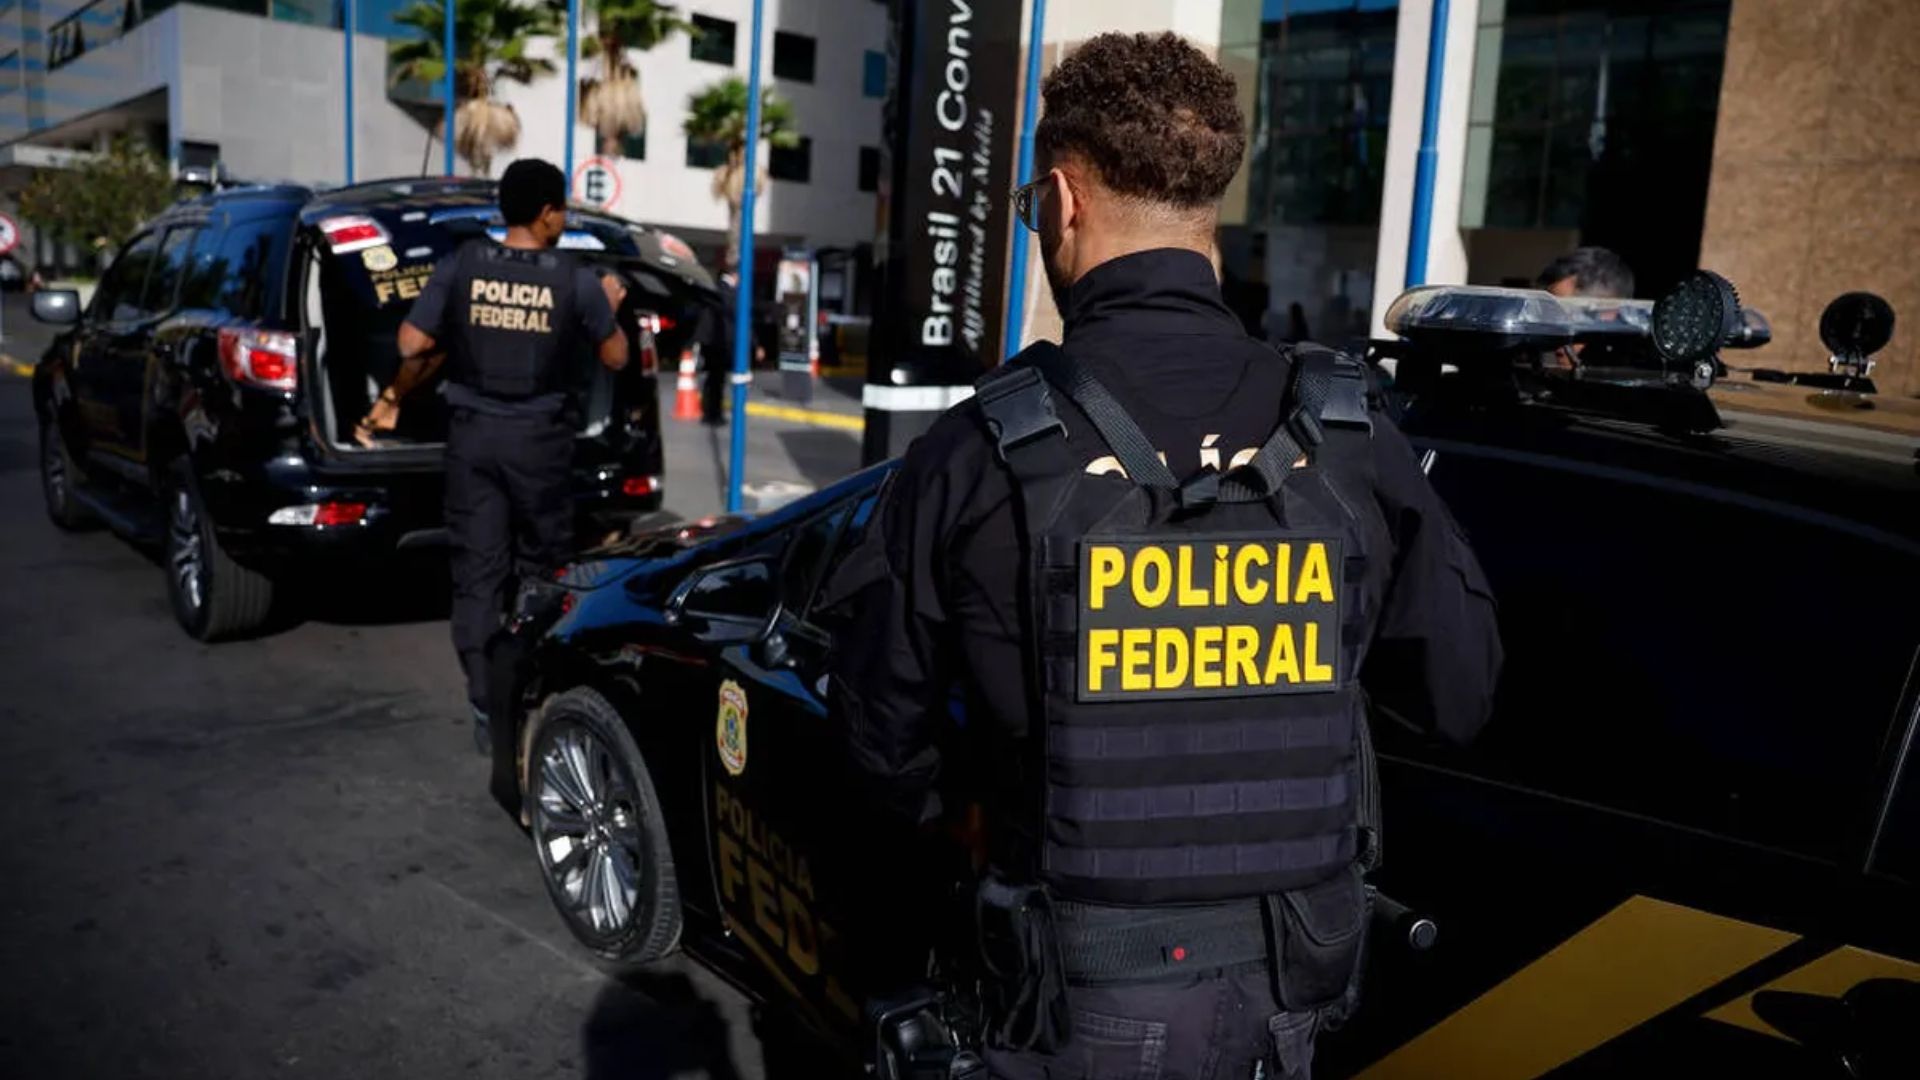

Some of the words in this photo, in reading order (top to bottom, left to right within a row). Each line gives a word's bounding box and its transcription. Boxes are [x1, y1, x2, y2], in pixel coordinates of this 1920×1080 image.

[587, 169, 606, 202] E
[930, 148, 964, 198] 21
[471, 279, 554, 310] POLICIA
[922, 212, 960, 346] Brasil
[470, 304, 552, 333] FEDERAL
[1088, 622, 1333, 692] FEDERAL
